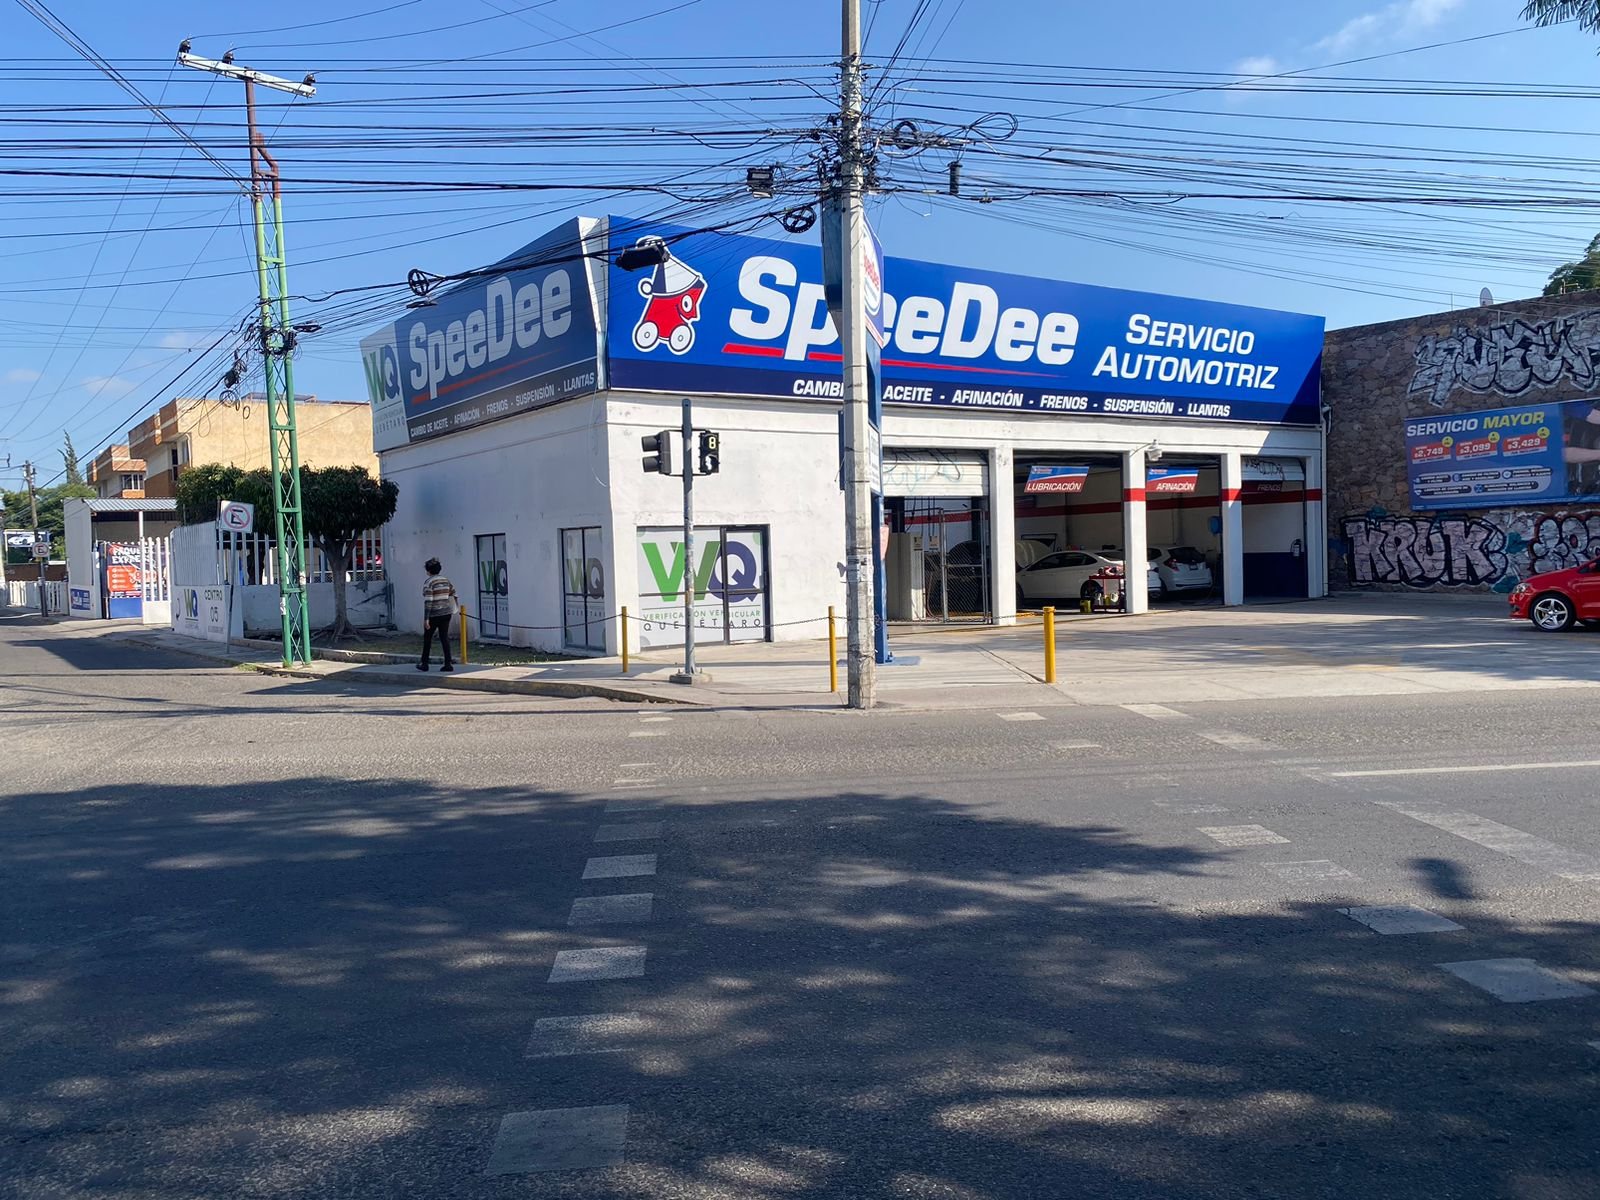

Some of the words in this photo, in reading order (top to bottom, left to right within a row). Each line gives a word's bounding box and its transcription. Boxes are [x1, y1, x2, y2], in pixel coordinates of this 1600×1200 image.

[409, 269, 573, 400] SpeeDee
[1125, 313, 1255, 355] SERVICIO
[1092, 345, 1279, 390] AUTOMOTRIZ
[433, 417, 449, 431] ACEITE
[486, 399, 509, 414] FRENOS
[515, 384, 555, 407] SUSPENSIÓN
[563, 372, 595, 392] LLANTAS
[793, 379, 844, 397] CAMBI
[883, 385, 933, 402] ACEITE
[952, 389, 1024, 407] AFINACIÓN
[1040, 394, 1089, 410] FRENOS
[1103, 398, 1175, 414] SUSPENSIÓN
[1187, 403, 1231, 417] LLANTAS
[1406, 418, 1479, 437] SERVICIO
[1483, 411, 1545, 429] MAYOR
[708, 436, 716, 449] 8
[1026, 481, 1082, 491] LUBRICACIÓN
[1155, 481, 1196, 491] AFINACIÓN
[643, 610, 706, 620] VERIFICAÓN
[643, 618, 761, 631] QUEÉTARO
